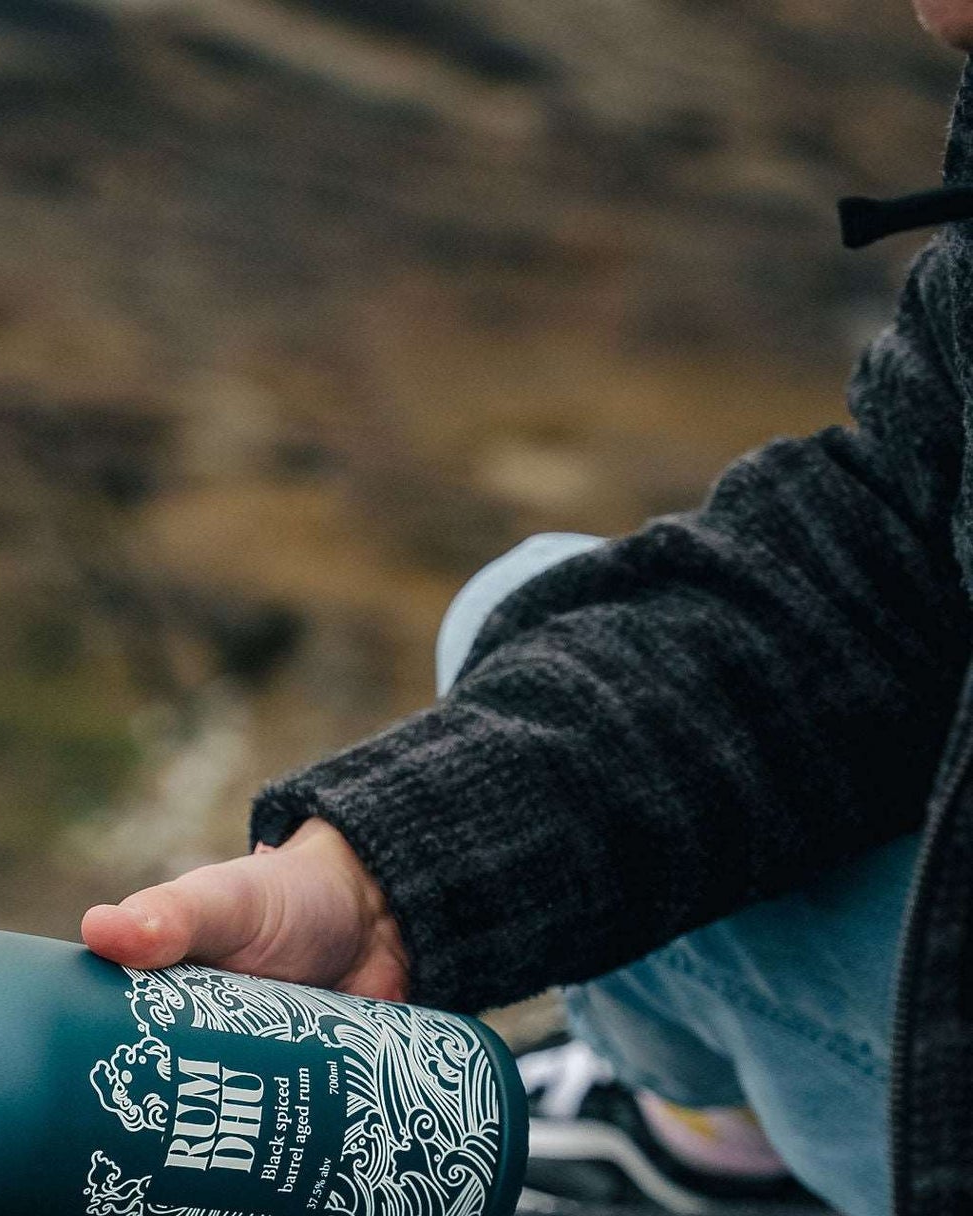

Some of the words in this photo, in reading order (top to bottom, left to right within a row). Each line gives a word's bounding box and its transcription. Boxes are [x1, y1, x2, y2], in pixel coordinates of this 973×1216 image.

[298, 1067, 310, 1102] rum
[326, 1060, 339, 1095] 700ml
[164, 1056, 221, 1171] RUM
[209, 1066, 264, 1173] DHU
[260, 1135, 286, 1181] Black
[273, 1076, 293, 1132] spiced
[295, 1105, 312, 1144] aged
[277, 1147, 304, 1193] barrel
[306, 1180, 325, 1210] 37.5%
[319, 1157, 332, 1178] abv
